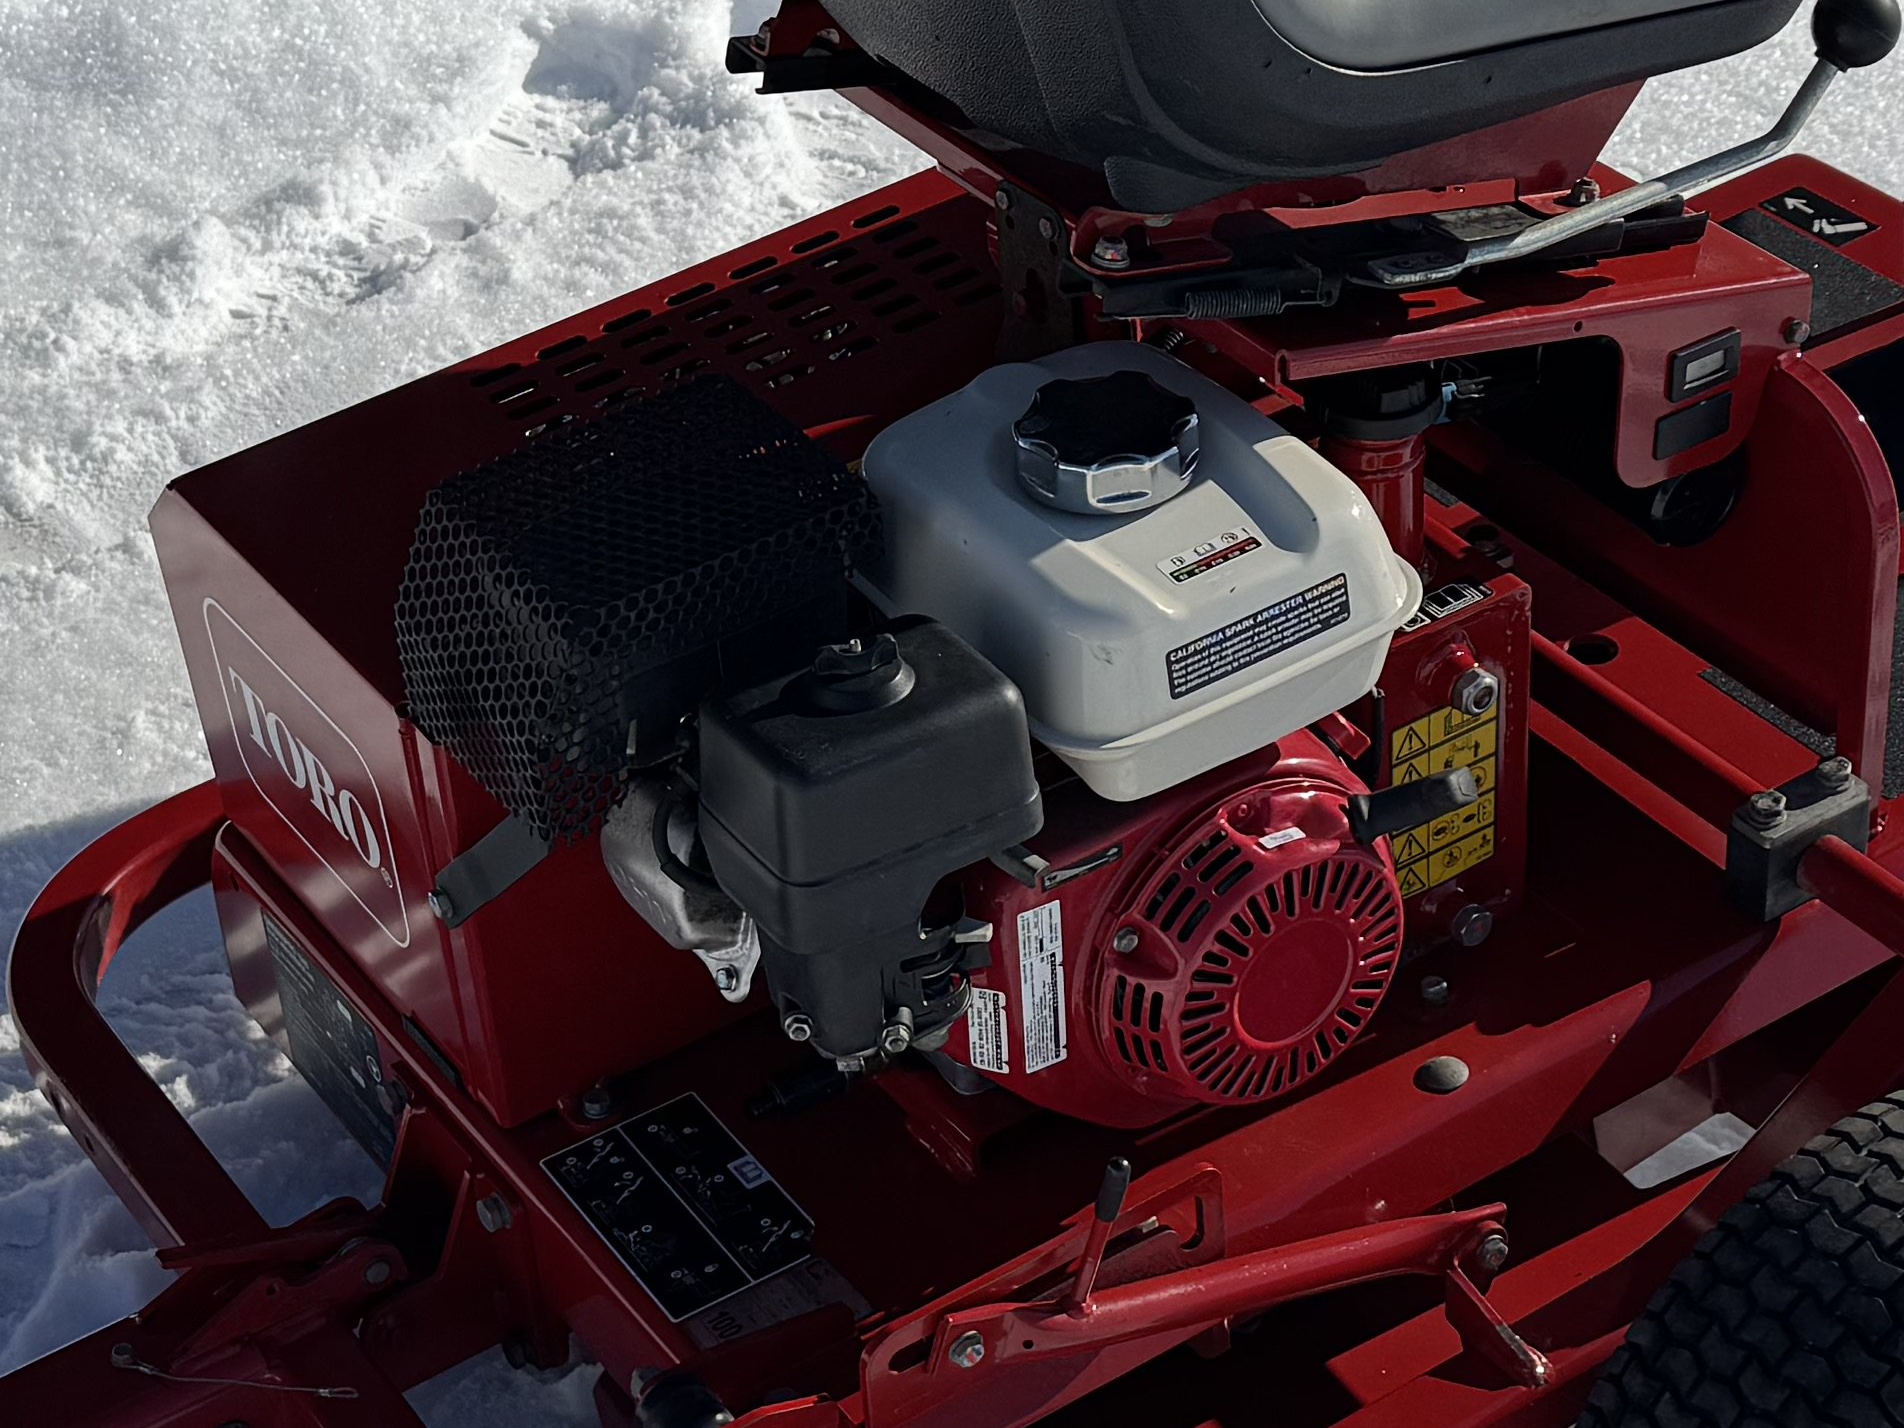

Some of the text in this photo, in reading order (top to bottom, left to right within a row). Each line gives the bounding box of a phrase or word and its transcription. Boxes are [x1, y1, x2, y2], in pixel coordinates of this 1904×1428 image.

[1170, 632, 1223, 661] CALIFORNIA
[1225, 618, 1254, 636] SPARK
[1257, 596, 1302, 622] ARRESTER
[1305, 576, 1344, 600] WARNING
[228, 666, 381, 868] TORO
